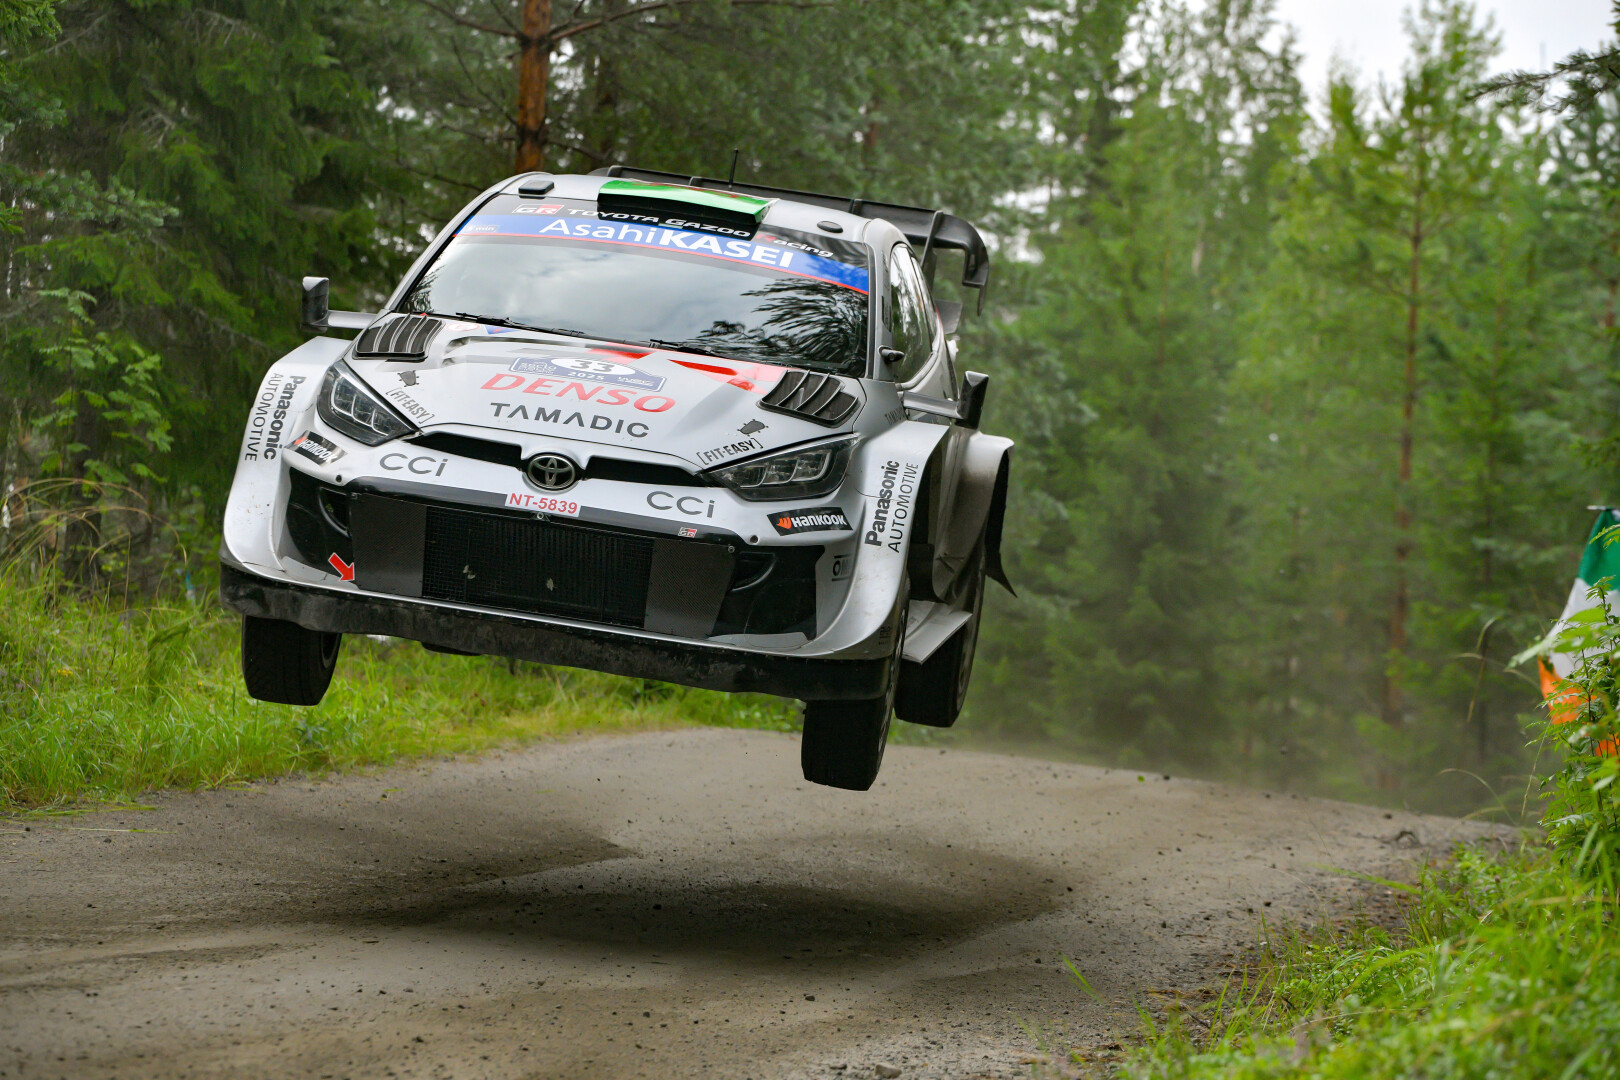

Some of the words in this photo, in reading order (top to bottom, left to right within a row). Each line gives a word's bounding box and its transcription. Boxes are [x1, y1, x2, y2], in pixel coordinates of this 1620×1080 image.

[515, 206, 558, 214] GR
[567, 208, 659, 223] TOYOTA
[665, 218, 751, 238] GAZOO
[539, 218, 794, 268] AsahiKASEI
[567, 371, 605, 380] 2025
[570, 359, 615, 373] 33
[480, 373, 676, 413] DENSO
[244, 372, 285, 462] AUTOMOTIVE
[264, 375, 307, 460] Panasonic
[490, 402, 650, 438] TAMADIC
[509, 492, 579, 514] NT-5839
[864, 460, 900, 547] Panasonic
[887, 462, 919, 553] AUTOMOTIVE
